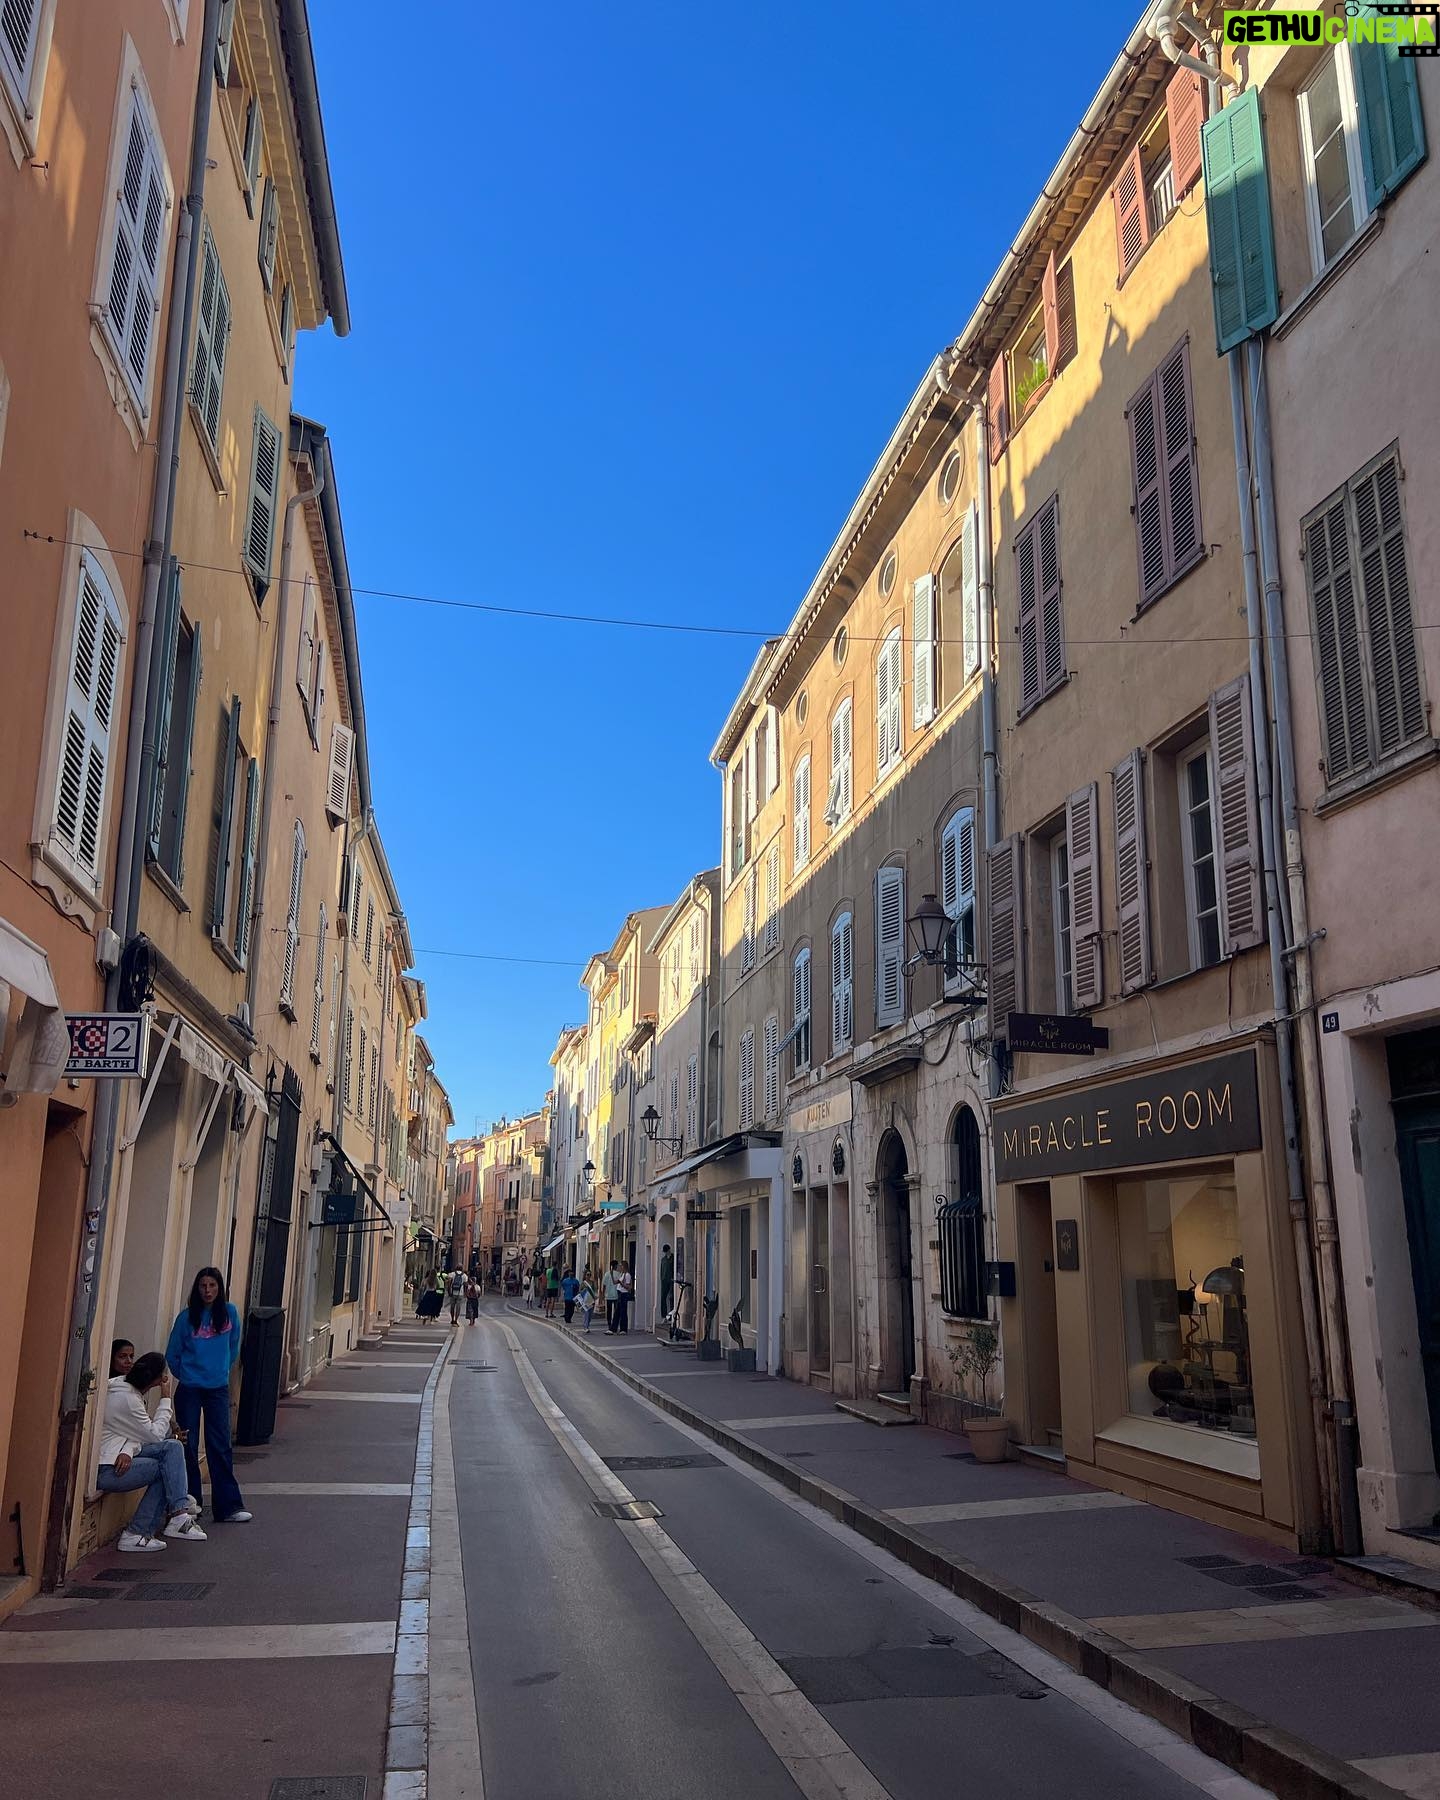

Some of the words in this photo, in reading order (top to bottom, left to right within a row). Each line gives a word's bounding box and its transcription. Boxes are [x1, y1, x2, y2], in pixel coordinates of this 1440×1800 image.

[1325, 1016, 1336, 1029] 49
[1010, 1039, 1058, 1049] MIRACLE
[1060, 1042, 1091, 1051] ROOM
[84, 1059, 131, 1069] BARTH
[1003, 1109, 1113, 1161] MIRACLE
[1136, 1082, 1234, 1139] ROOM
